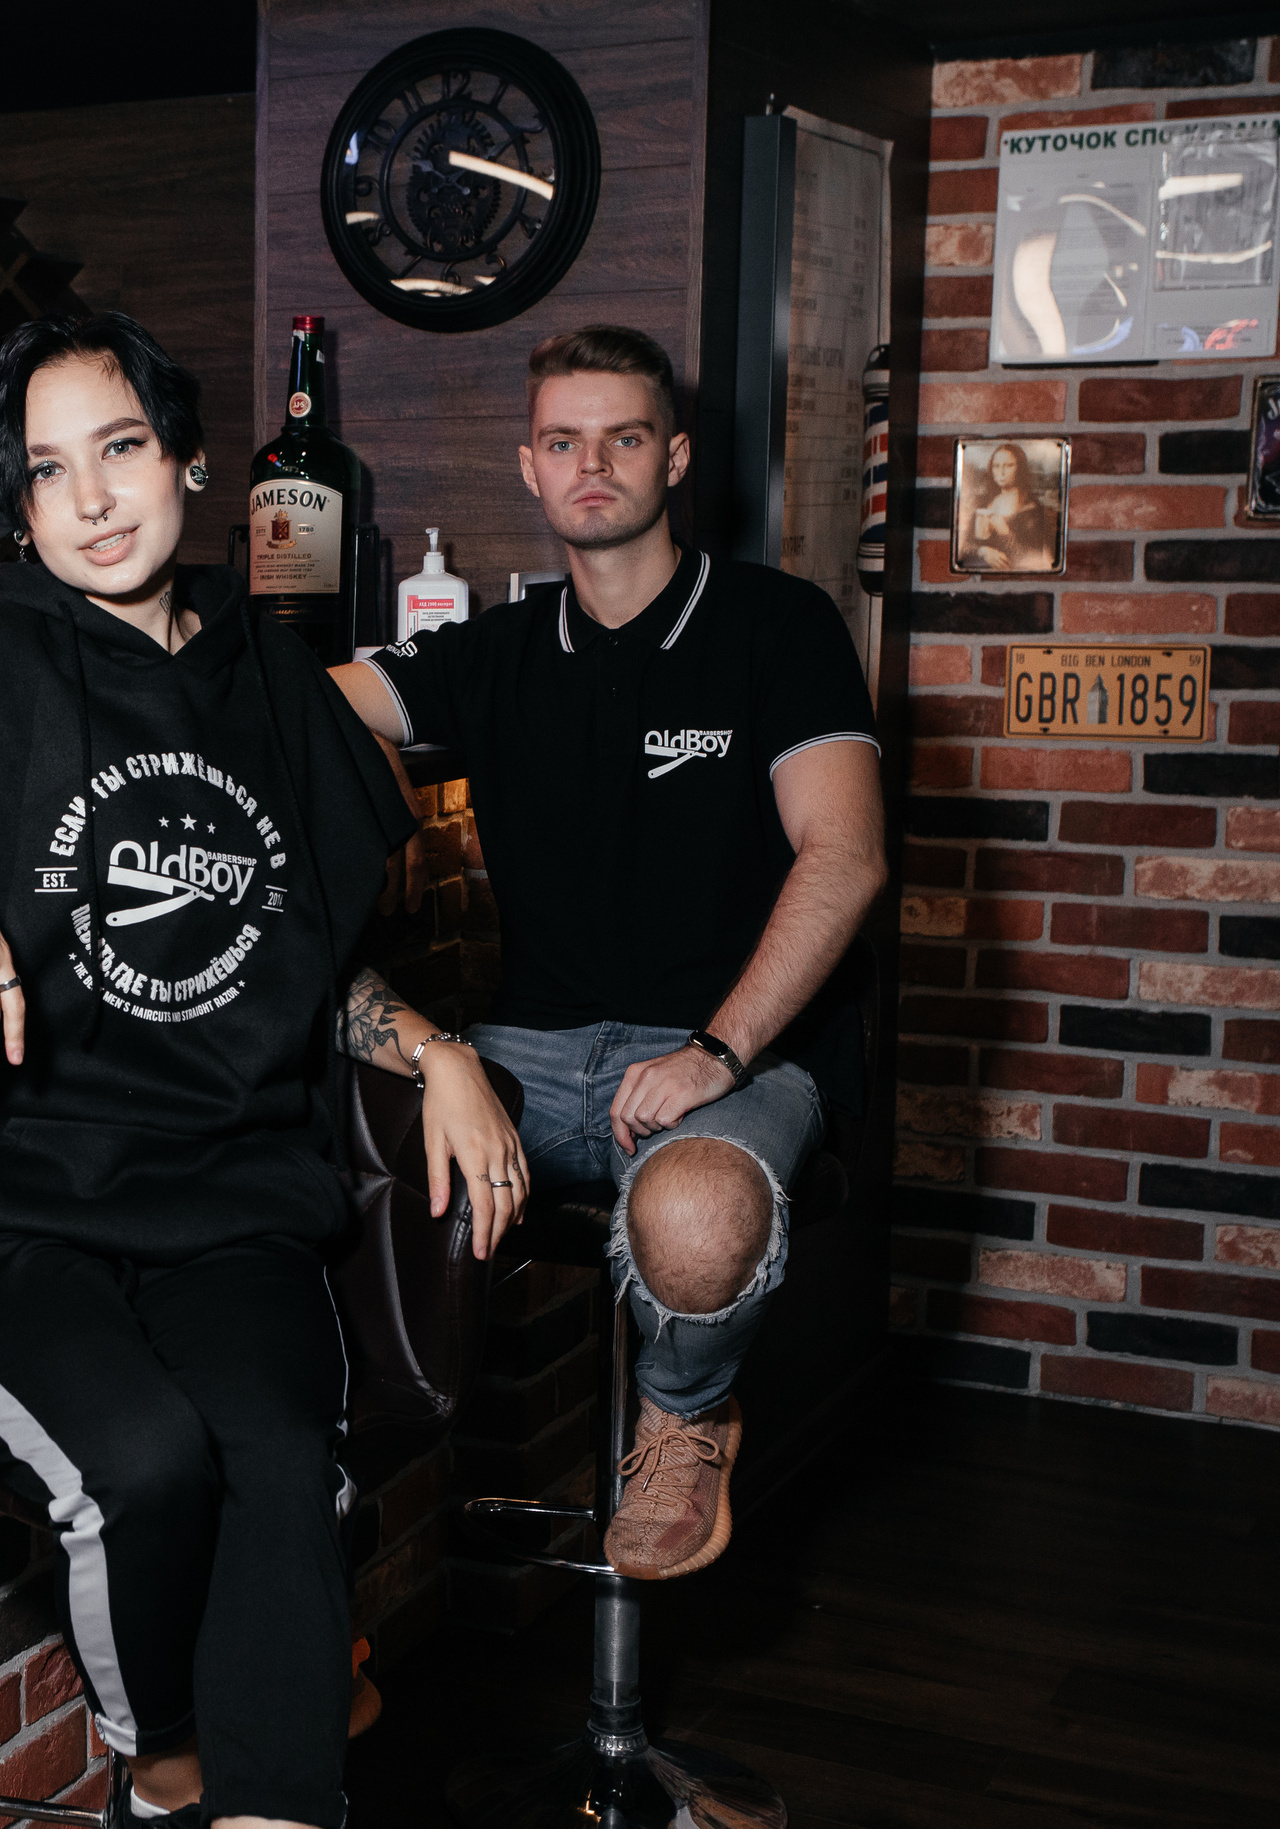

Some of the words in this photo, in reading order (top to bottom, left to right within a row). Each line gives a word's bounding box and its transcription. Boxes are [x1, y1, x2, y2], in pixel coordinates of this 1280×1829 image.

[1009, 130, 1117, 155] КУТОЧОК
[251, 486, 327, 516] JAMESON
[276, 572, 308, 580] WHISKEY
[1061, 655, 1079, 667] BIG
[1085, 655, 1105, 667] BEN
[1111, 655, 1151, 667] LONDON
[1189, 655, 1201, 667] 59
[1015, 672, 1081, 724] GBR
[1117, 673, 1197, 726] 1859
[644, 729, 732, 758] OldBoy
[125, 752, 258, 818] СТРИЖЁШЬСЯ
[256, 815, 281, 850] НЕ
[269, 852, 286, 869] В
[109, 840, 255, 905] OldBoy
[207, 851, 257, 867] BARBERSHOP
[42, 873, 69, 888] EST.
[109, 961, 148, 997] ГДЕ
[149, 978, 171, 1003] ТЫ
[174, 923, 262, 1002] СТРИЖЁШЬСЯ
[73, 961, 89, 980] THE
[102, 990, 131, 1013] MEN'S
[131, 1004, 171, 1023] HAIRCUTS
[181, 1000, 215, 1022] STRAIGHT
[213, 985, 240, 1009] RAZOR
